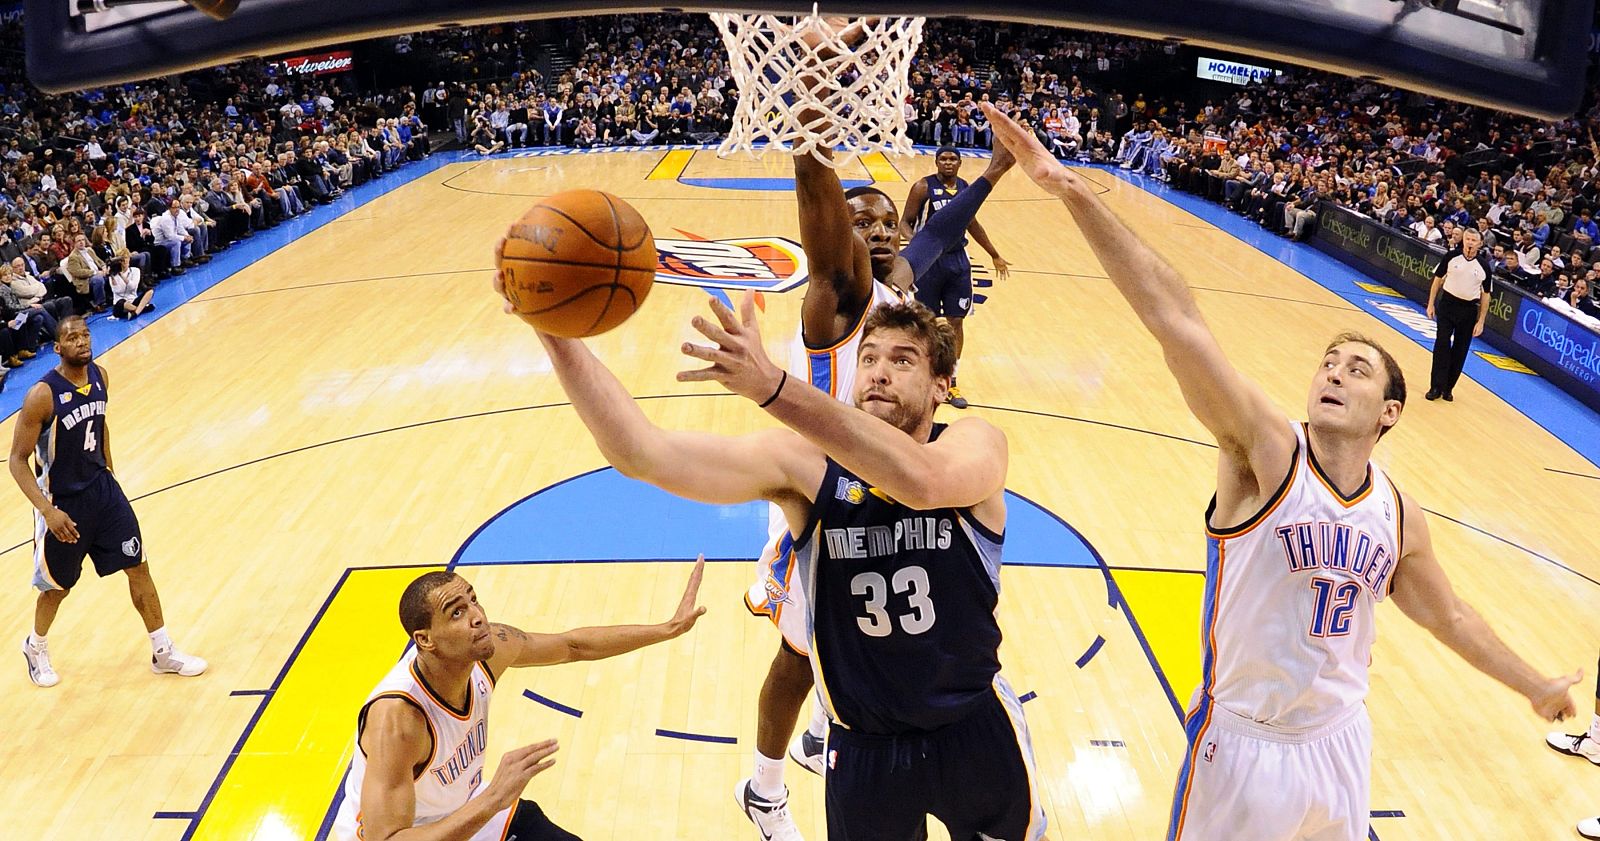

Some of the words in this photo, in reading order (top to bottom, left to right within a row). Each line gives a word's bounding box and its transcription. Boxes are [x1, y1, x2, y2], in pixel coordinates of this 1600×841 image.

[270, 56, 352, 75] dweiser
[1208, 62, 1272, 80] HOMELAN
[1321, 210, 1370, 249] Chesapeake
[1376, 235, 1434, 280] Chesapeake
[1564, 360, 1596, 384] ENERGY
[61, 400, 106, 431] MEMPHI
[83, 420, 97, 452] 4
[824, 517, 953, 560] MEMPHIS
[1275, 521, 1394, 599] THUNDER
[765, 582, 784, 597] OKC
[850, 565, 936, 637] 33
[1309, 576, 1362, 638] 12
[430, 718, 487, 787] THUND
